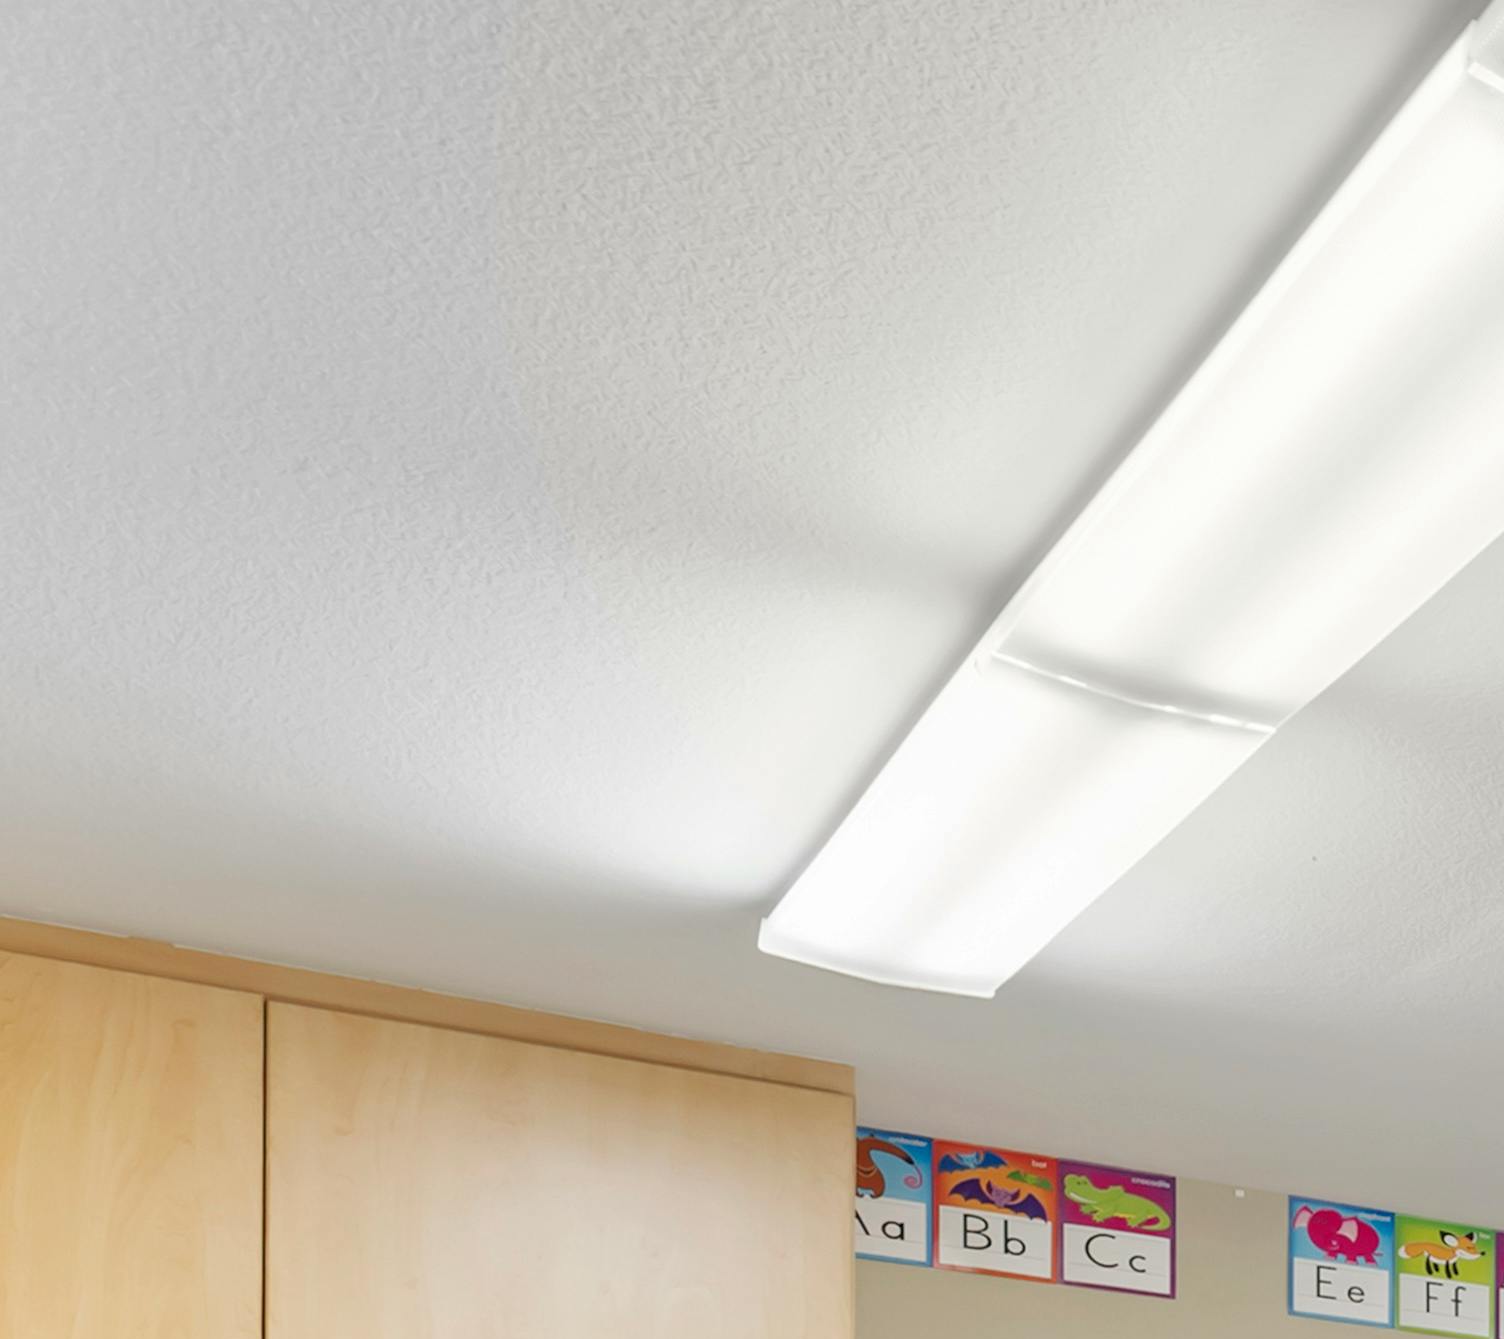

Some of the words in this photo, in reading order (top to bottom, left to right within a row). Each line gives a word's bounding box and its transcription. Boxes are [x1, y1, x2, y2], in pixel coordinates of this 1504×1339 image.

[856, 1209, 905, 1241] a
[962, 1213, 1027, 1256] Bb
[1085, 1233, 1147, 1274] Cc
[1315, 1264, 1366, 1304] Ee
[1424, 1280, 1467, 1318] Ff
